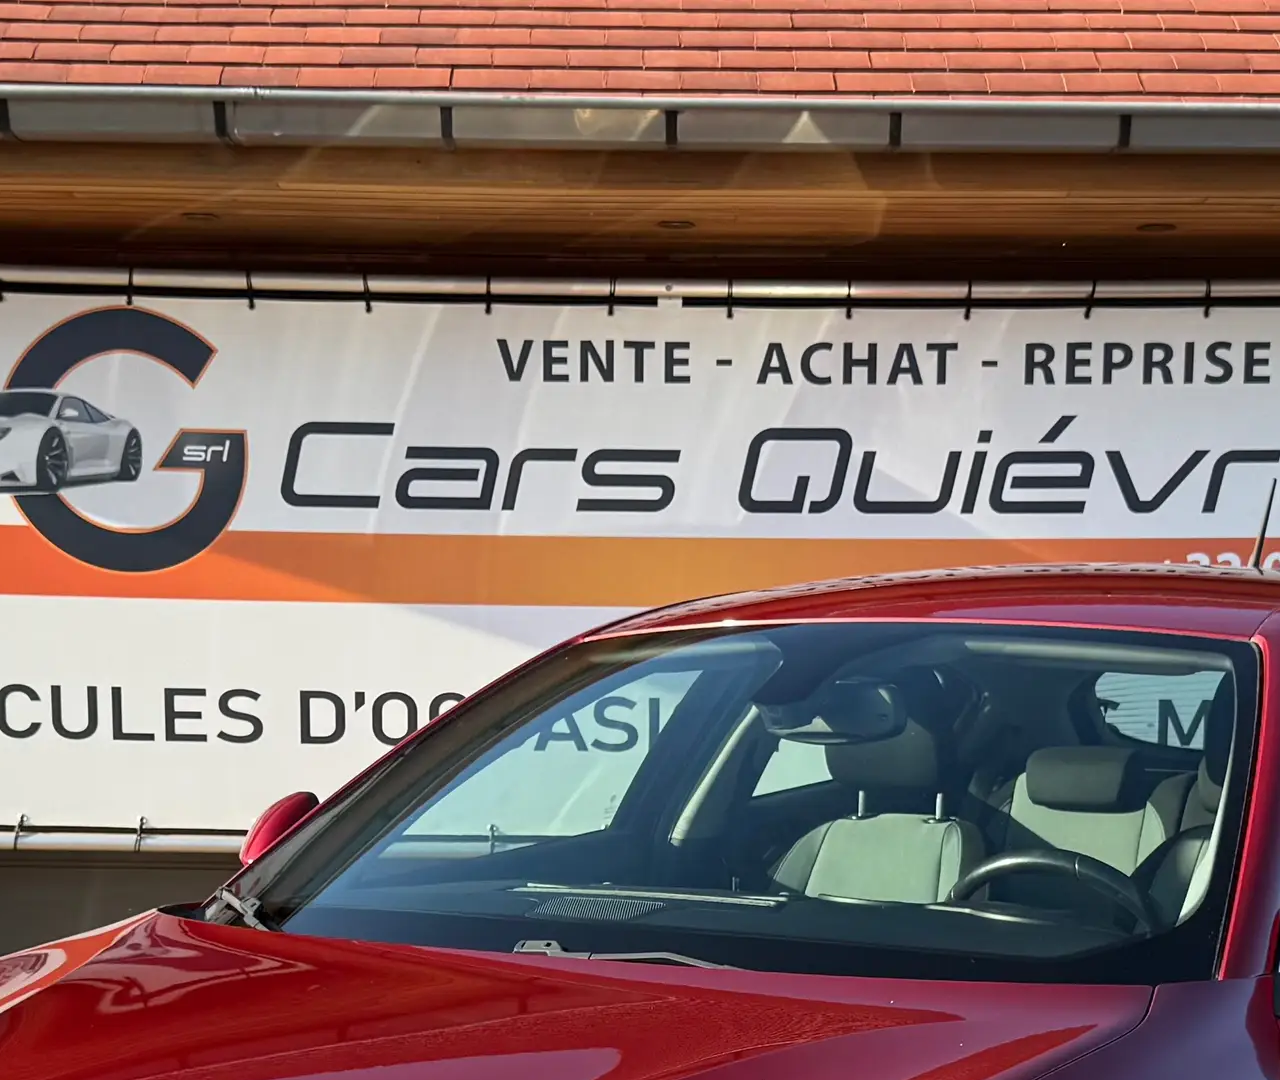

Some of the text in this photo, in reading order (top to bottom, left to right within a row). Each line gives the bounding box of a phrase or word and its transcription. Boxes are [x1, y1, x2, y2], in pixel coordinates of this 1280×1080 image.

[496, 338, 692, 384] VENTE
[756, 341, 959, 386] ACHAT
[1023, 341, 1273, 386] REPRISE
[280, 420, 682, 514] Cars
